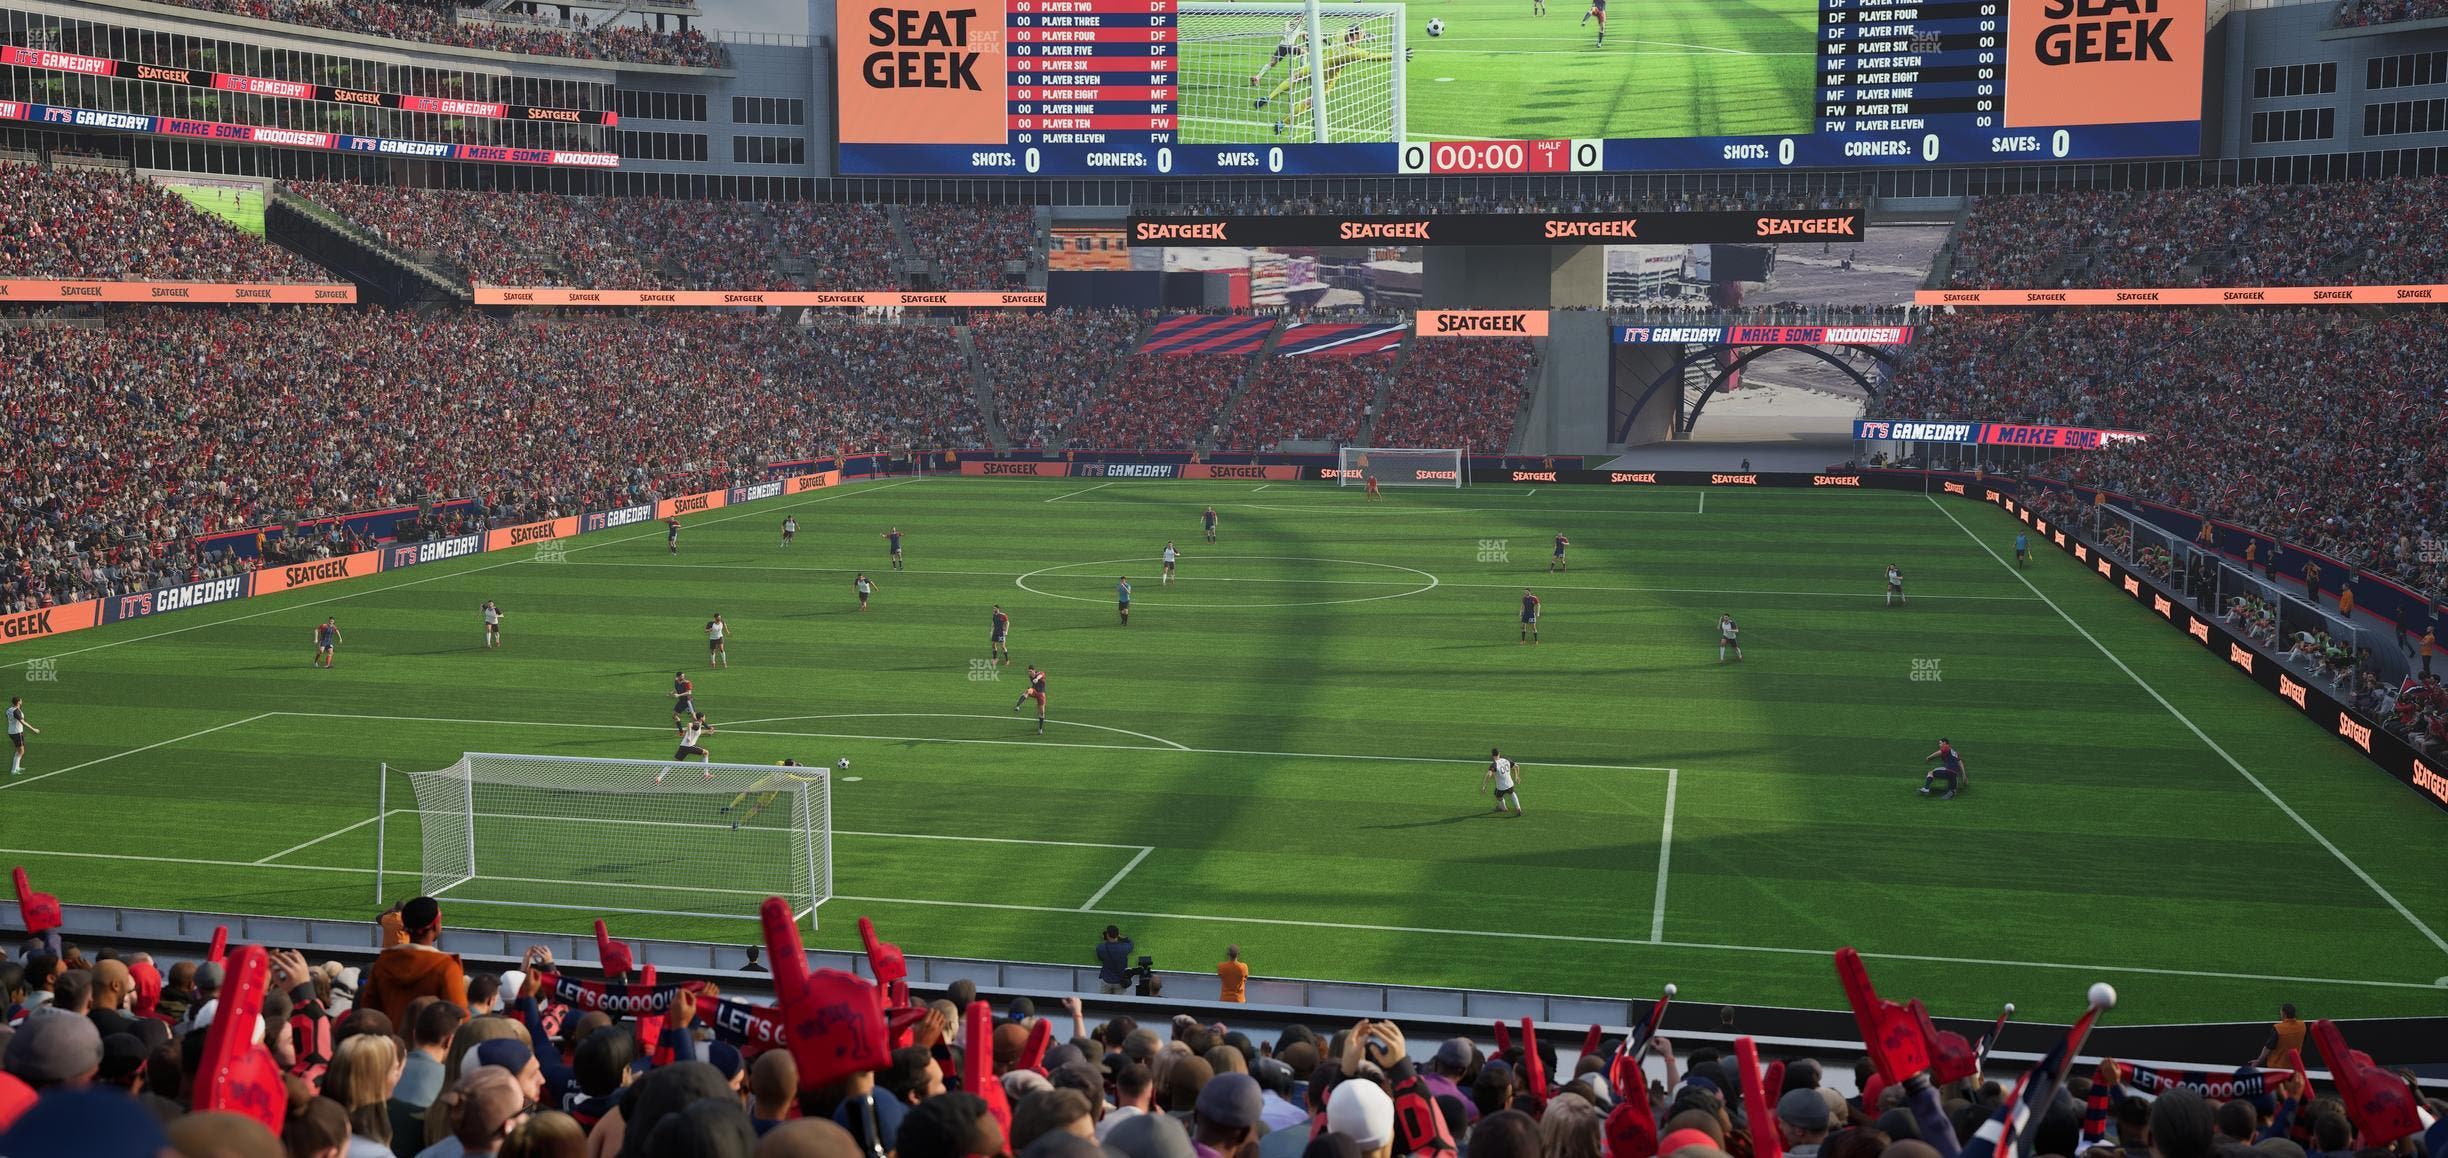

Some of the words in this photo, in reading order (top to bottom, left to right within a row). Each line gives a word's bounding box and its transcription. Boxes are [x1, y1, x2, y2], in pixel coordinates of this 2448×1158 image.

[1042, 2, 1072, 11] PLAYER
[1074, 2, 1091, 11] TWO
[1151, 2, 1165, 11] DF
[1042, 17, 1072, 26] PLAYER
[1074, 17, 1099, 26] THREE
[1151, 17, 1165, 26] DF
[1829, 12, 1845, 23] DF
[1859, 11, 1892, 21] PLAYER
[1895, 9, 1917, 20] FOUR
[869, 8, 976, 46] SEAT
[1042, 32, 1072, 40] PLAYER
[1074, 32, 1095, 40] FOUR
[1151, 31, 1165, 40] DF
[1829, 28, 1845, 38] DF
[1859, 26, 1891, 37] PLAYER
[1894, 25, 1914, 35] FIVE
[1829, 44, 1846, 54] MF
[1858, 42, 1891, 53] PLAYER
[1893, 41, 1908, 51] SIX
[2035, 18, 2173, 65] GEEK
[1042, 46, 1072, 55] PLAYER
[1074, 46, 1092, 55] FIVE
[1151, 46, 1166, 55] DF
[15, 50, 38, 64] IT'S
[42, 53, 104, 76] GAMEDAY!
[863, 51, 981, 91] GEEK
[1043, 61, 1072, 70] PLAYER
[1074, 61, 1087, 70] SIX
[1151, 61, 1167, 70] MF
[1828, 59, 1845, 69] MF
[1858, 58, 1890, 68] PLAYER
[1893, 56, 1921, 67] SEVEN
[138, 66, 189, 84] SEATGEEK
[1043, 75, 1072, 84] PLAYER
[1075, 76, 1100, 84] SEVEN
[1151, 75, 1167, 84] MF
[1828, 75, 1845, 85] MF
[1857, 73, 1890, 84] PLAYER
[1892, 72, 1918, 82] EIGHT
[227, 77, 247, 90] IT'S
[250, 80, 304, 97] GAMEDAY!
[1043, 90, 1072, 99] PLAYER
[1075, 90, 1098, 99] EIGHT
[1151, 90, 1167, 99] MF
[1827, 91, 1844, 100] MF
[1857, 89, 1889, 99] PLAYER
[1892, 88, 1913, 98] NINE
[335, 90, 380, 105] SEATGEEK
[418, 99, 438, 111] IT'S
[442, 101, 497, 116] GAMEDAY!
[528, 108, 580, 122] SEATGEEK
[1043, 105, 1072, 113] PLAYER
[1075, 105, 1093, 113] NINE
[1151, 104, 1167, 113] MF
[1827, 106, 1846, 116] FW
[1856, 105, 1889, 115] PLAYER
[1891, 104, 1908, 114] TEN
[44, 108, 72, 123] IT'S
[76, 108, 149, 130] GAMEDAY!
[170, 121, 210, 135] MAKE
[216, 126, 250, 139] SOME
[1043, 119, 1073, 128] PLAYER
[1075, 119, 1090, 128] TEN
[1151, 119, 1169, 128] FW
[1826, 121, 1845, 131] FW
[1856, 120, 1888, 130] PLAYER
[1891, 119, 1924, 129] ELEVEN
[1043, 134, 1073, 143] PLAYER
[1075, 134, 1105, 143] ELEVEN
[1152, 134, 1169, 143] FW
[1992, 136, 2040, 152] SAVES:
[2053, 130, 2069, 157] 0
[351, 138, 376, 151] IT'S
[380, 140, 448, 156] GAMEDAY!
[469, 148, 506, 159] MAKE
[513, 151, 549, 162] SOME
[1578, 144, 1596, 167] 0
[1724, 145, 1768, 159] SHOTS:
[1779, 139, 1794, 165] 0
[1845, 141, 1910, 156] CORNERS:
[1923, 134, 1939, 161] 0
[972, 153, 1015, 166] SHOTS:
[1026, 148, 1040, 173] 0
[1087, 153, 1146, 166] CORNERS:
[1158, 148, 1171, 172] 0
[1218, 153, 1258, 166] SAVES:
[1269, 147, 1283, 172] 0
[1406, 147, 1423, 169] 0
[1437, 145, 1523, 169] 00:00
[1546, 151, 1552, 167] 1
[1137, 223, 1226, 240] SEATGEEK
[1341, 222, 1429, 239] SEATGEEK
[1545, 220, 1636, 238] SEATGEEK
[1757, 217, 1853, 235] SEATGEEK
[61, 286, 102, 296] SEATGEEK
[315, 290, 348, 299] SEATGEEK
[724, 294, 764, 303] SEATGEEK
[901, 295, 946, 303] SEATGEEK
[2117, 293, 2158, 301] SEATGEEK
[2314, 291, 2352, 299] SEATGEEK
[2397, 290, 2431, 298] SEATGEEK
[1438, 314, 1526, 332] SEATGEEK
[1625, 329, 1649, 342] IT'S
[1652, 328, 1721, 342] GAMEDAY!
[1741, 329, 1780, 342] MAKE
[1786, 329, 1822, 342] SOME
[1825, 329, 1900, 342] NOOOOISE!!!
[1861, 423, 1889, 438] IT'S
[1893, 424, 1969, 440] GAMEDAY!
[1998, 428, 2057, 444] MAKE
[2065, 431, 2097, 447] SOME
[982, 463, 1037, 476] SEATGEEK
[1081, 464, 1104, 477] IT'S
[1108, 465, 1171, 476] GAMEDAY!
[1211, 466, 1266, 479] SEATGEEK
[1513, 472, 1556, 481] SEATGEEK
[1612, 473, 1655, 483] SEATGEEK
[800, 474, 827, 492] SEATGEEK
[1712, 475, 1756, 484] SEATGEEK
[1814, 476, 1859, 486] SEATGEEK
[733, 487, 746, 503] IT'S
[748, 482, 781, 500] GAMEDAY!
[675, 495, 709, 515] SEATGEEK
[589, 513, 605, 531] IT'S
[608, 505, 650, 526] GAMEDAY!
[510, 522, 557, 546] SEATGEEK
[394, 546, 417, 568] IT'S
[420, 535, 478, 562] GAMEDAY!
[285, 556, 350, 588] SEATGEEK
[120, 593, 151, 619] IT'S
[157, 578, 240, 611] GAMEDAY!
[2280, 674, 2306, 709] SEATGEEK
[2340, 712, 2371, 753] SEATGEEK
[555, 979, 596, 1007] LET'S
[716, 1004, 772, 1042] LET'S
[2133, 1067, 2173, 1088] LET'S
